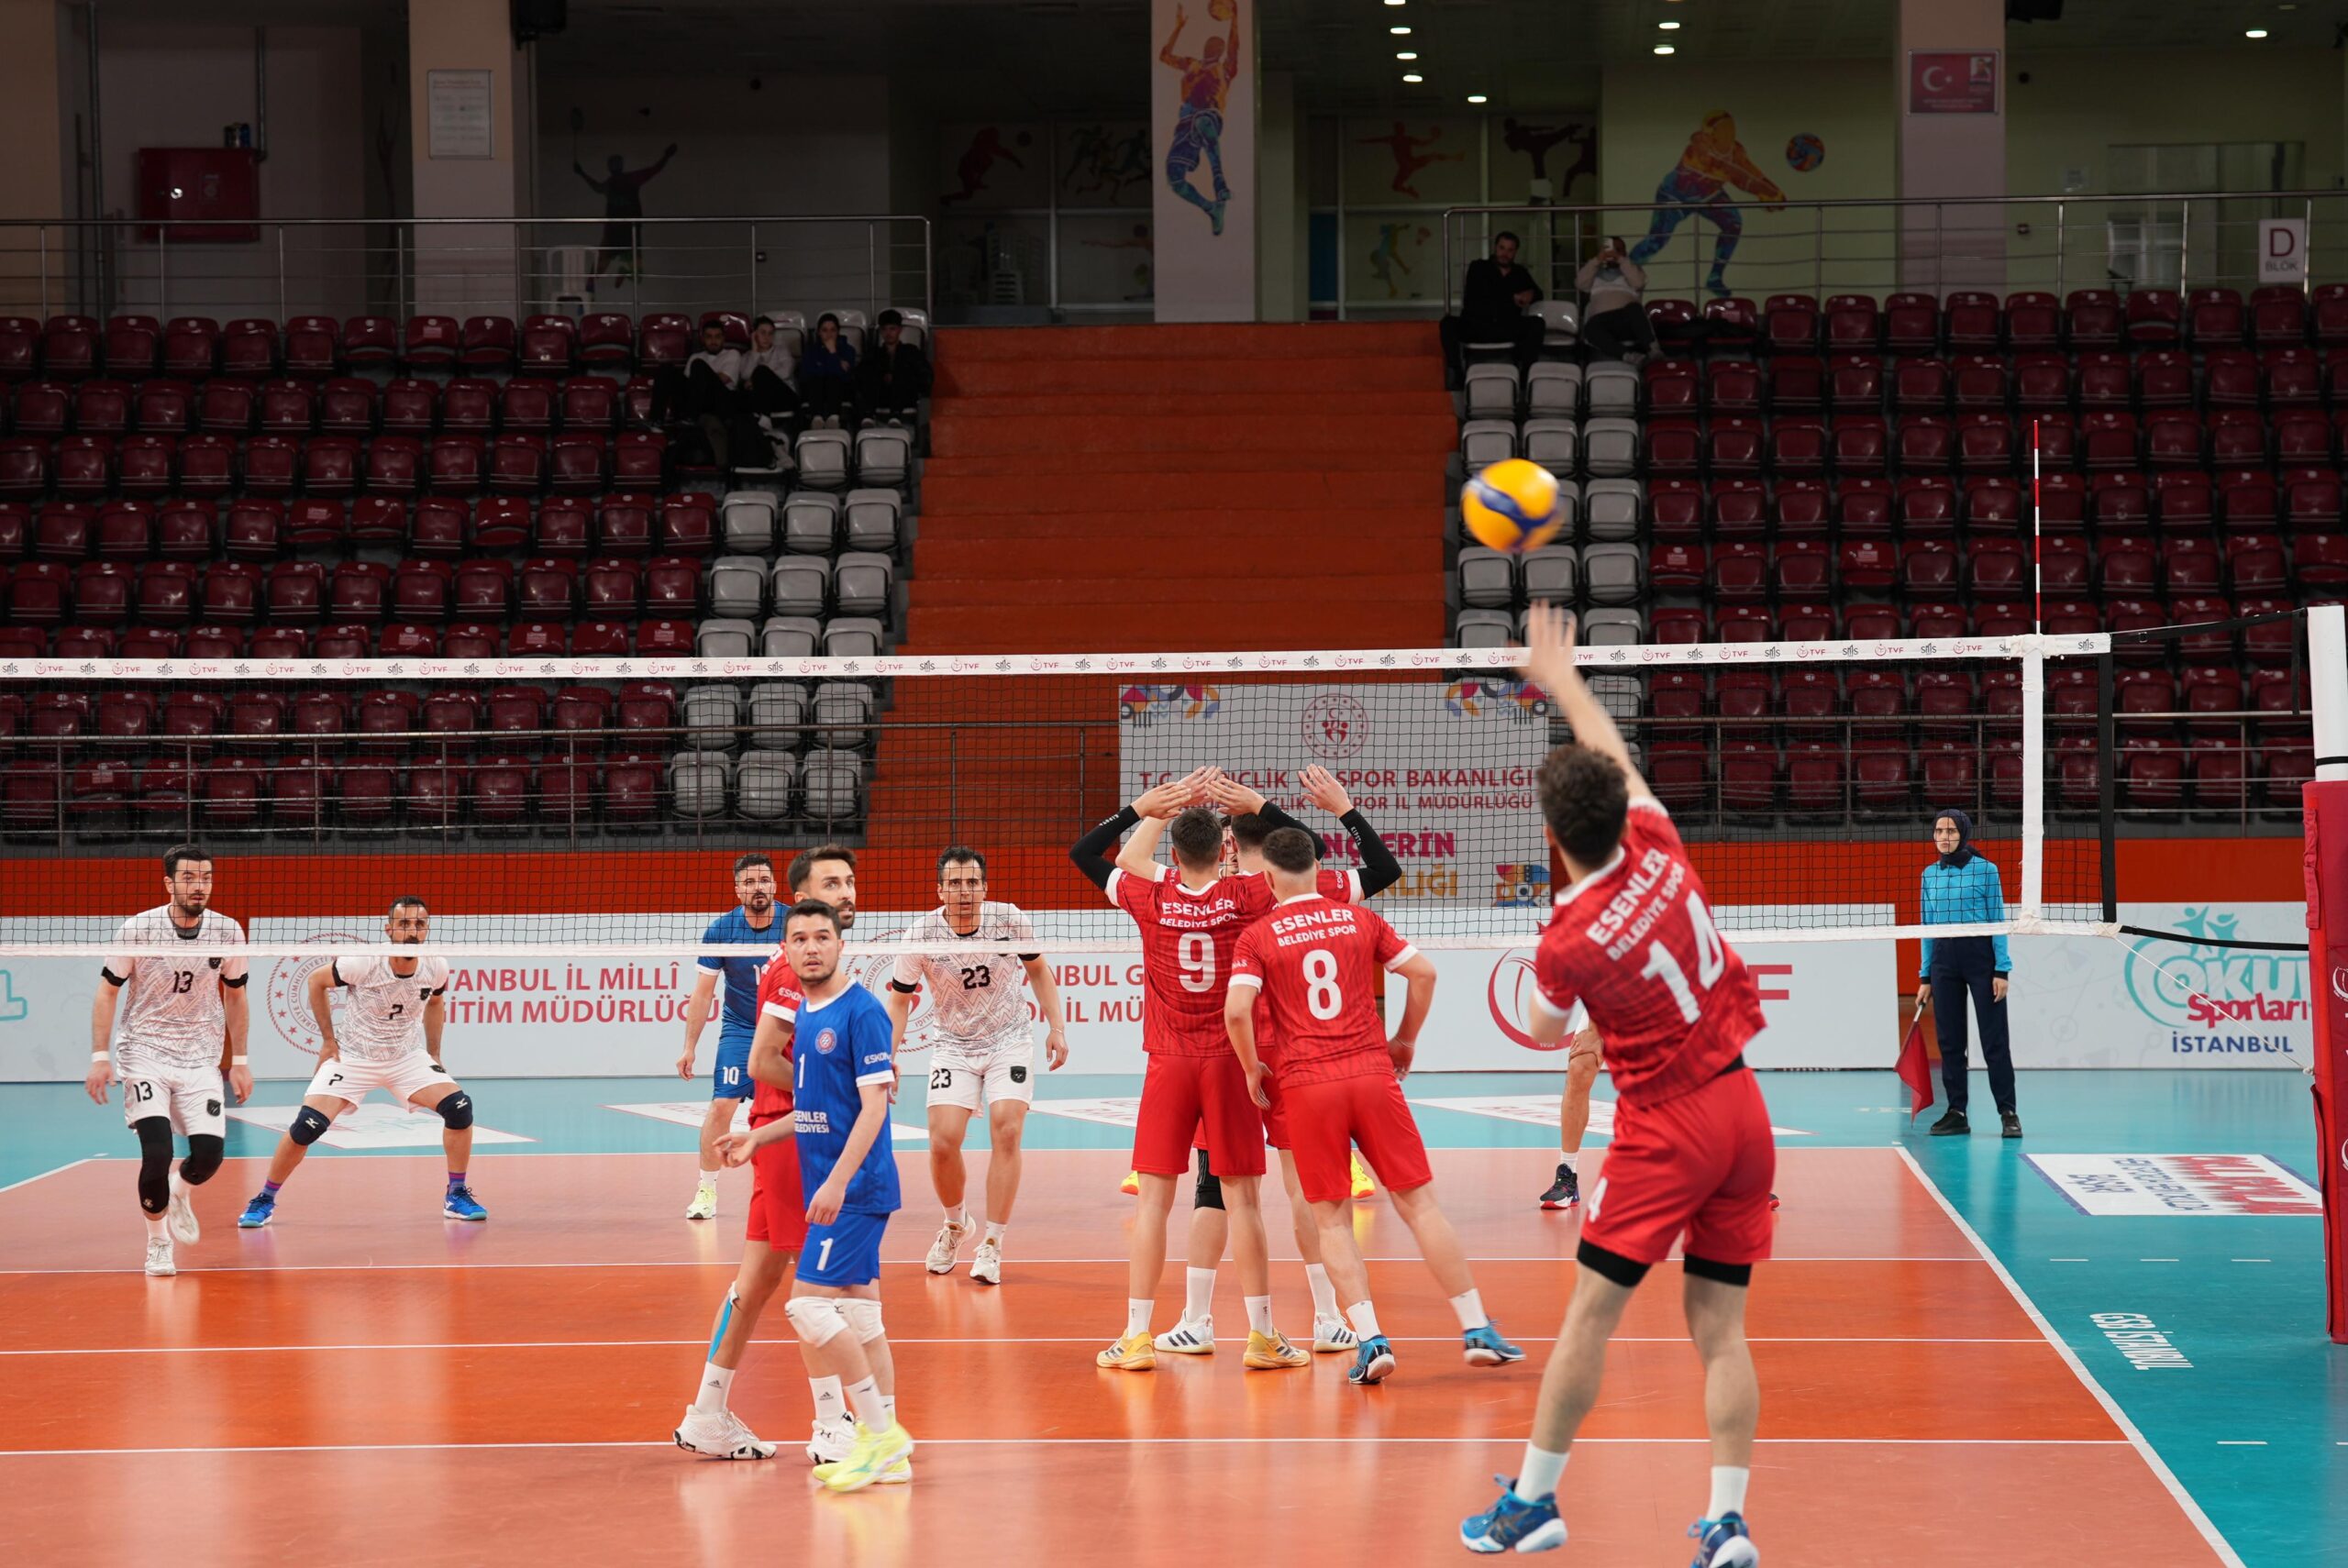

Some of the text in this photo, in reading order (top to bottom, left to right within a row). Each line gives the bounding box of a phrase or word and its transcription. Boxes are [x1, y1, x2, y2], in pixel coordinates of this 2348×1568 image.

[2270, 228, 2294, 257] D
[2265, 259, 2298, 272] BLOK
[1335, 769, 1396, 789] SPOR
[1406, 766, 1533, 788] BAKANLIĞI
[1353, 795, 1389, 810] POR
[1418, 792, 1533, 810] MÜDÜRLÜĞÜ
[1161, 898, 1236, 917] ESENLER
[1585, 846, 1670, 946] ESENLER
[1159, 918, 1208, 928] BELEDİYE
[1270, 909, 1356, 935] ESENLER
[1277, 923, 1357, 947] BELEDİYE SPOR
[1178, 931, 1216, 993] 9
[1640, 889, 1724, 1025] 14
[172, 970, 194, 994] 13
[566, 963, 591, 990] İL
[598, 961, 680, 990] MİLLÎ
[961, 965, 991, 990] 23
[1302, 948, 1343, 1021] 8
[389, 1003, 404, 1021] 7
[444, 996, 513, 1024] İTİM
[1066, 996, 1089, 1022] İL
[2187, 992, 2308, 1029] Sporları
[2171, 1031, 2294, 1054] İSTANBUL
[723, 1066, 740, 1086] 10
[799, 1054, 805, 1088] 1
[930, 1067, 952, 1090] 23
[133, 1081, 153, 1102] 13
[794, 1110, 827, 1123] SENLER
[816, 1237, 834, 1271] 1
[2089, 1312, 2195, 1370] GSB İSTANBUL
